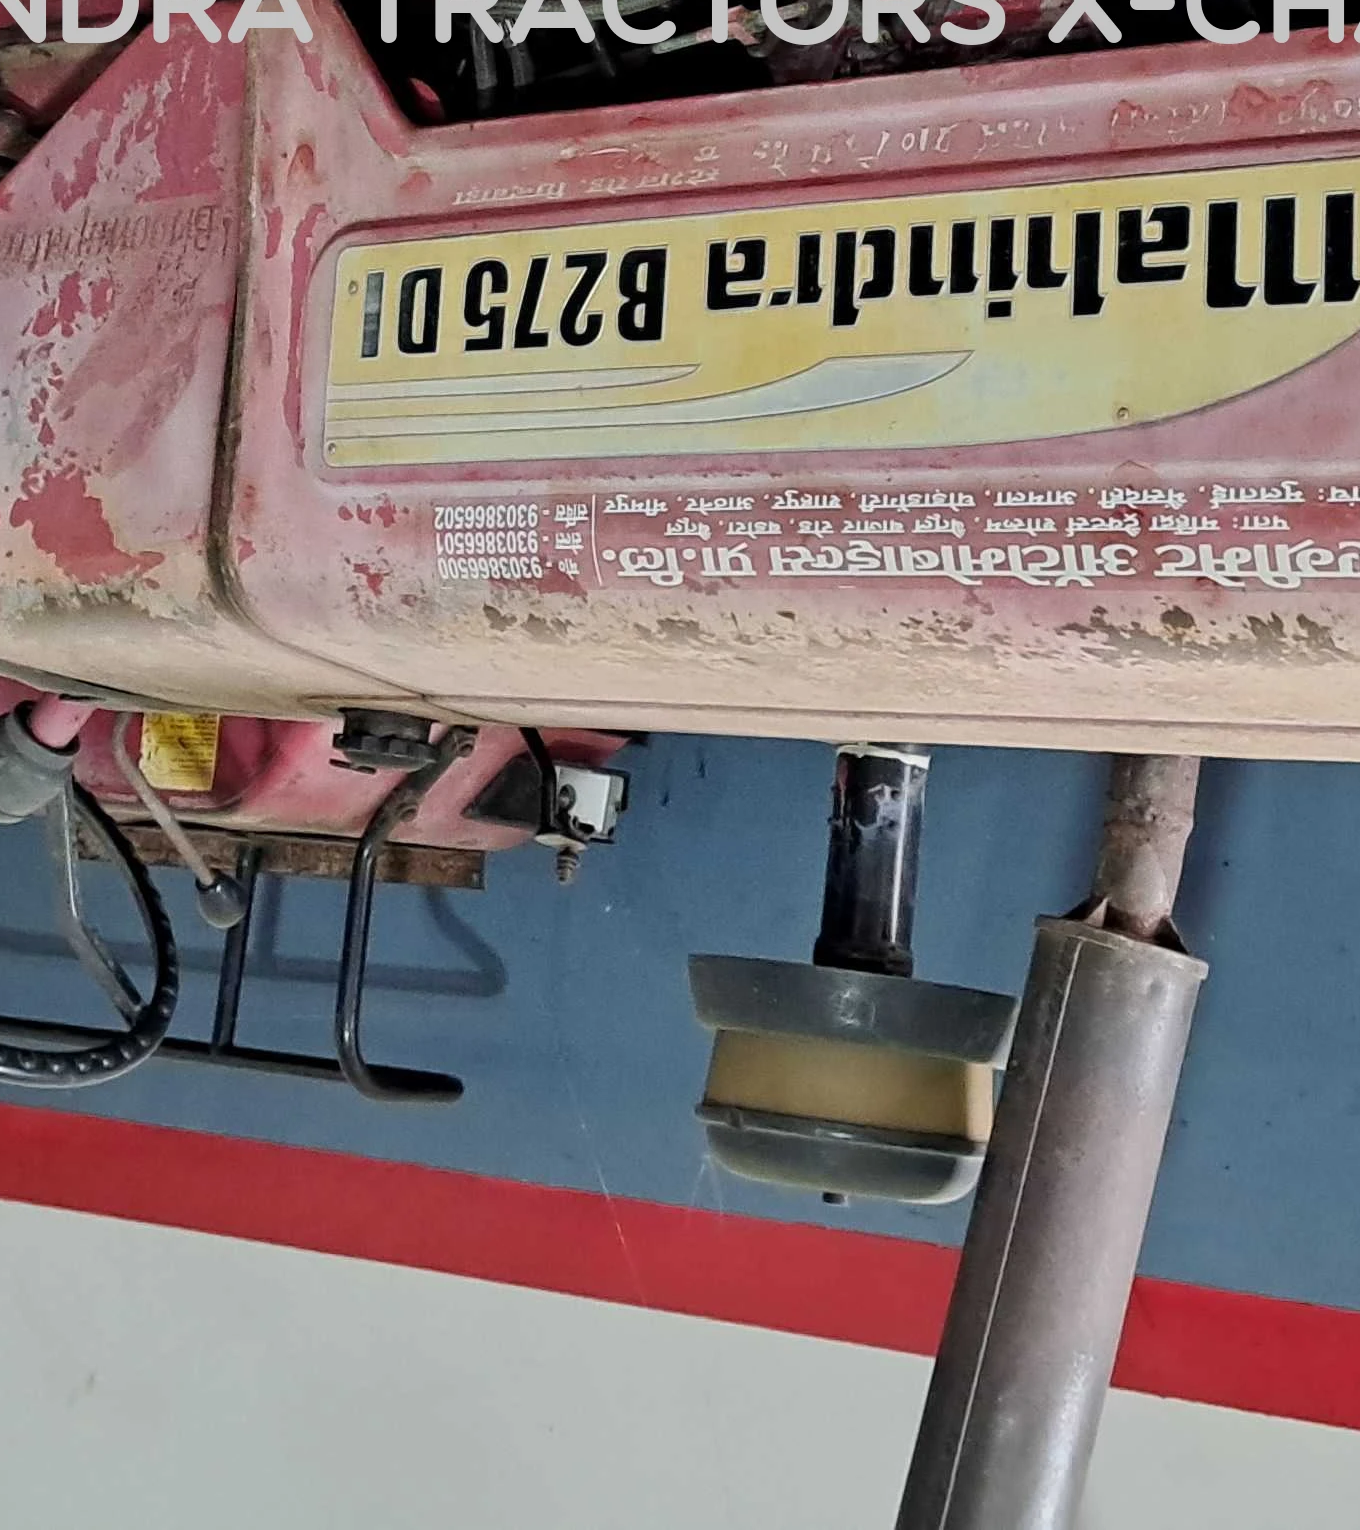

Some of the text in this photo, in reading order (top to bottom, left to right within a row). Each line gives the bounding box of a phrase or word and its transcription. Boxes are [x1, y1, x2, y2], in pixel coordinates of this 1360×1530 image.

[358, 265, 443, 359] DI
[464, 243, 669, 353] B275
[434, 504, 538, 530] 9303866502
[435, 530, 538, 555] 9303866501
[438, 556, 542, 580] 9303866500
[769, 539, 1137, 587] ऑटोमोबाइल्स
